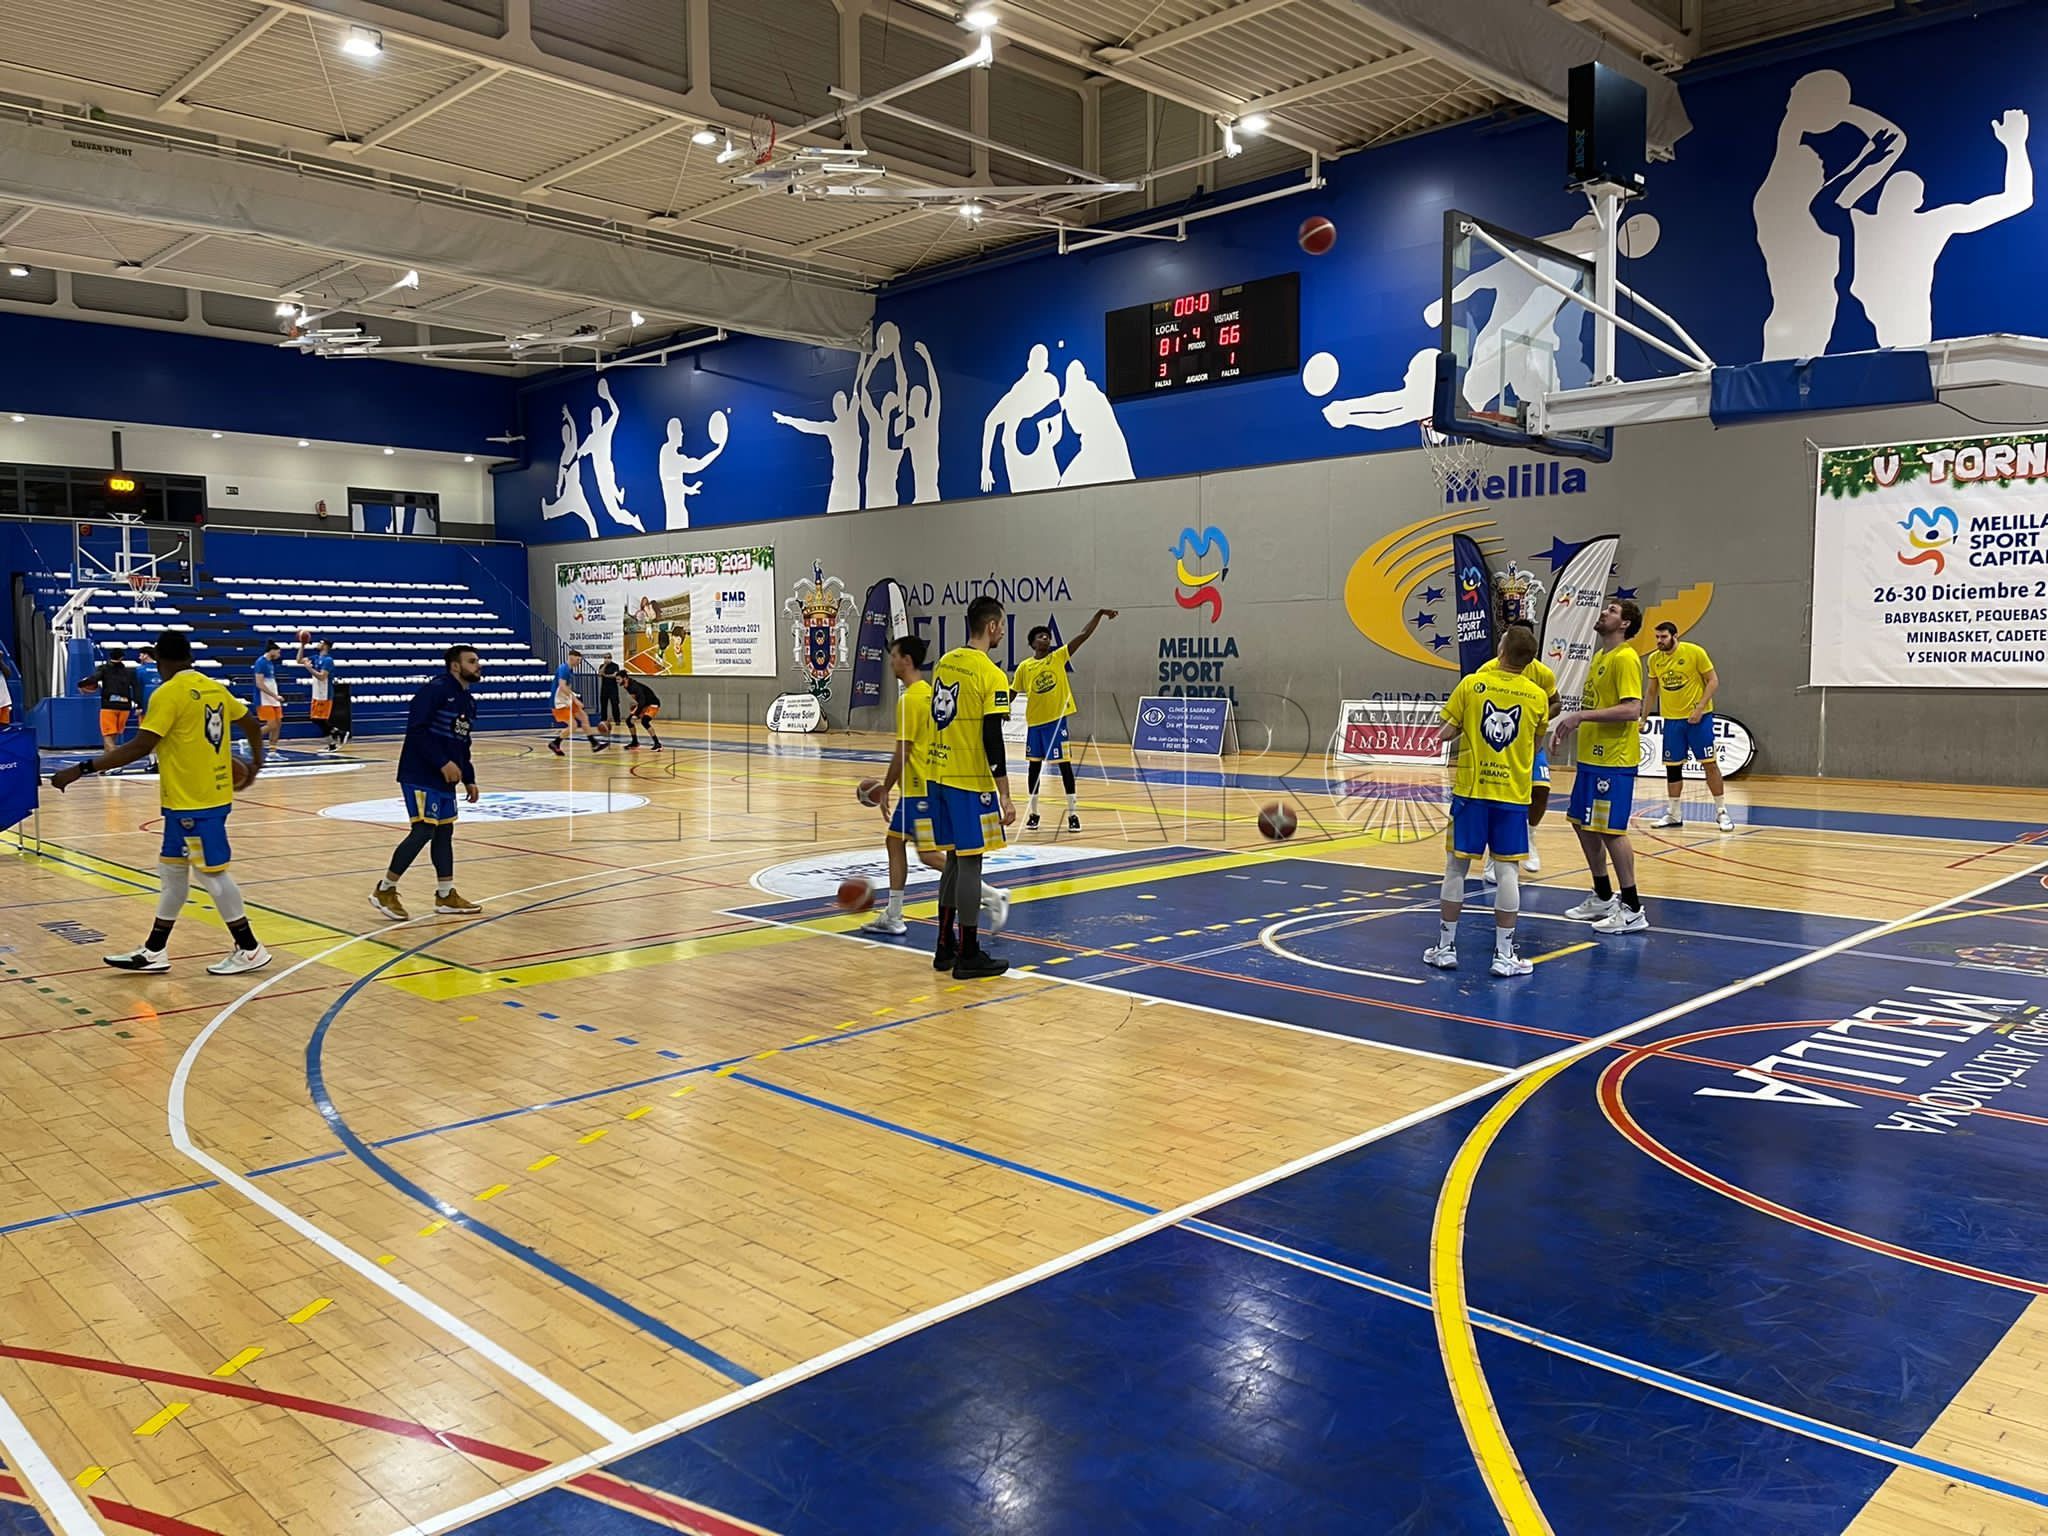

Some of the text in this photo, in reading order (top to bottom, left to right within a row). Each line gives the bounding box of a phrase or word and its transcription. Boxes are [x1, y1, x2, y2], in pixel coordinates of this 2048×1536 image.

[1213, 310, 1240, 324] VISITANTE
[1155, 323, 1180, 336] LOCAL
[1218, 324, 1241, 346] 66
[1159, 336, 1180, 357] 81
[1159, 363, 1168, 377] 3
[1220, 367, 1241, 378] FALTAS
[1154, 379, 1173, 389] FALTAS
[1185, 373, 1209, 385] JUGADOR
[1872, 454, 1901, 487] V
[1446, 462, 1587, 504] Melilla
[1969, 532, 2041, 550] SPORT
[580, 566, 618, 583] TORNEO
[622, 565, 638, 580] DE
[641, 561, 687, 578] NAVIDAD
[690, 556, 718, 575] FMB
[721, 553, 753, 572] 2021
[942, 573, 1073, 607] AUTÓNOMA
[1873, 581, 2047, 603] 26-30 Diciembre 2
[1884, 610, 1972, 625] BABYBASKET,
[721, 624, 746, 634] Diciembre
[747, 623, 761, 633] 2021
[1457, 620, 1481, 633] SPORT
[1907, 631, 1993, 644] MINIBASKET,
[1158, 637, 1239, 658] MELILLA
[1907, 650, 2045, 664] Y SENIOR MACULINO
[1158, 661, 1224, 682] SPORT
[782, 711, 801, 721] Enrique
[1592, 744, 1604, 757] 26
[1703, 746, 1713, 758] 12
[1692, 984, 2029, 1110] MELILLA
[1873, 1043, 2046, 1135] AUTÓNOMA
